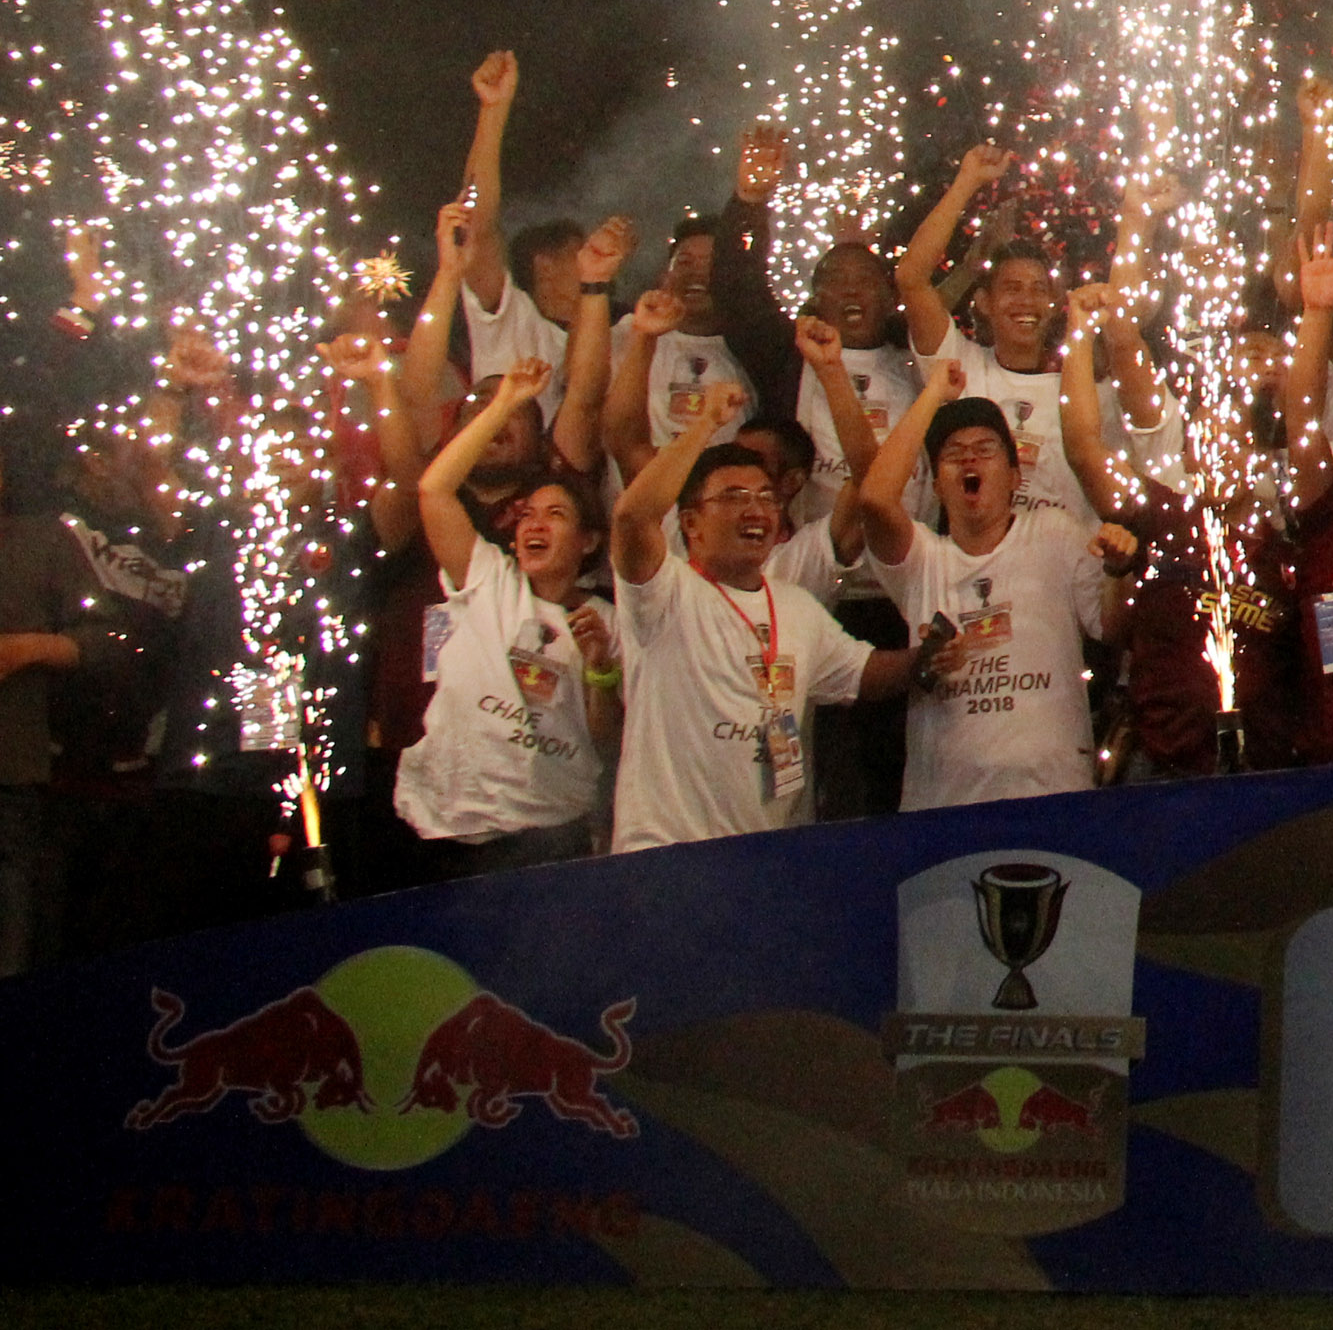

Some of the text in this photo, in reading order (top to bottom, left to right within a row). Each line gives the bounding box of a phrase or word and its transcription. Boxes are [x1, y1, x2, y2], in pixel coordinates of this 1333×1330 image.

[969, 655, 1010, 675] THE
[938, 672, 1051, 699] HAMPION
[967, 697, 1015, 715] 2018
[904, 1024, 1123, 1048] THE FINALS
